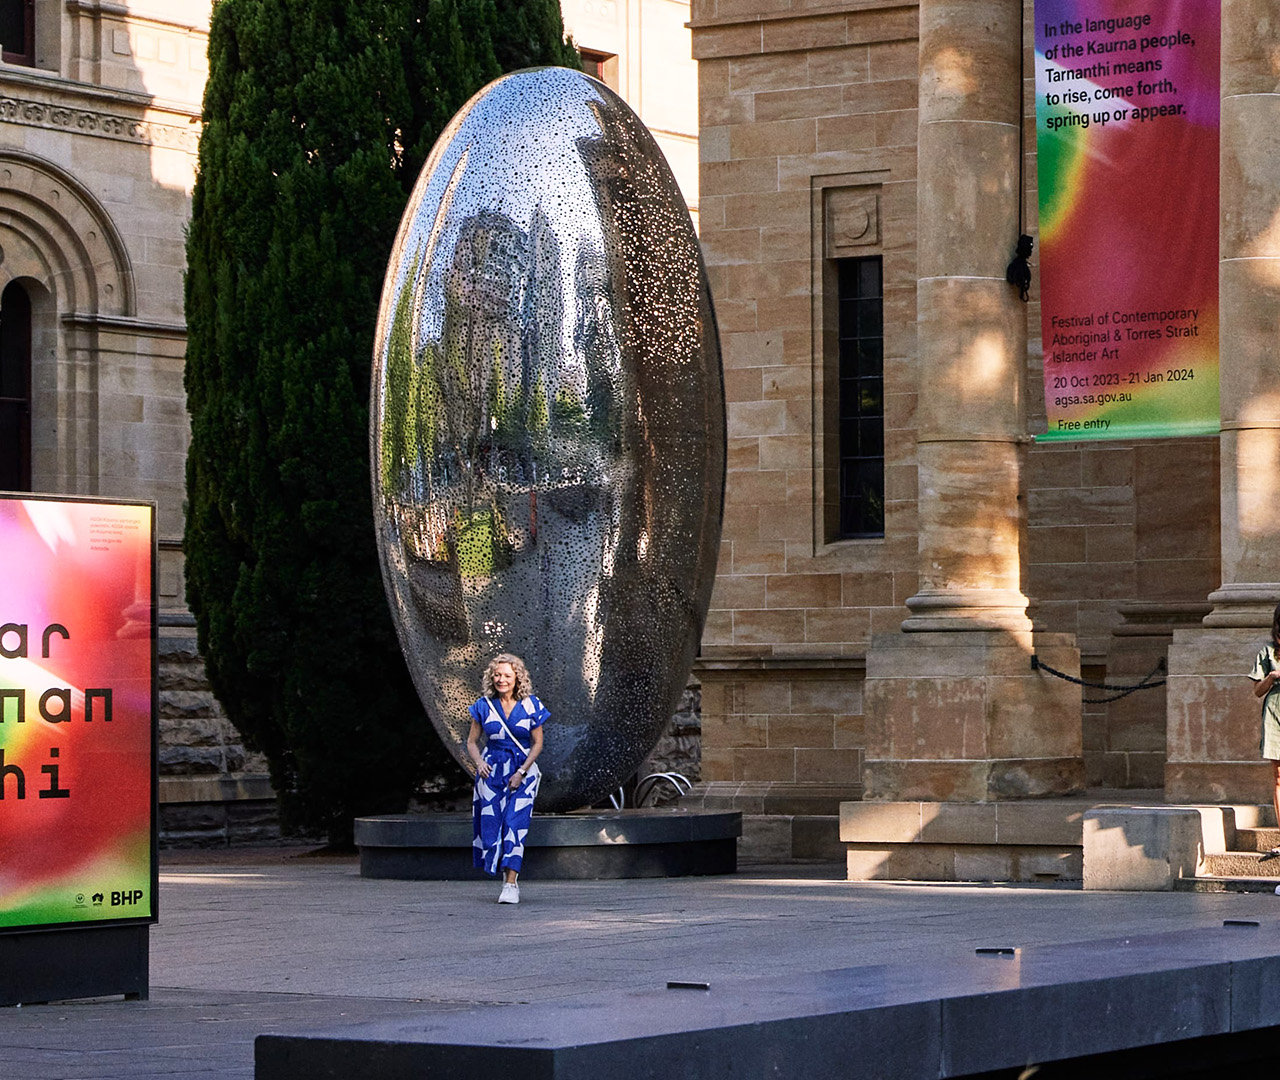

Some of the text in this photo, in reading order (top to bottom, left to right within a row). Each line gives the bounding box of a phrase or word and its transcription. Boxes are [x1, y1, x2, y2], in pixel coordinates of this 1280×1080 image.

[1045, 15, 1150, 38] In the language
[1045, 30, 1195, 60] of the Kaurna people,
[1045, 60, 1162, 82] Tarnanthi means
[1046, 78, 1176, 105] to rise, come forth,
[1047, 104, 1186, 131] spring up or appear.
[1052, 309, 1198, 328] Festival of Contemporary
[1052, 326, 1198, 347] Aboriginal & Torres Strait
[1053, 347, 1119, 363] Islander Art
[1054, 377, 1067, 388] 20
[1070, 376, 1089, 387] Oct
[1144, 372, 1163, 383] Jan
[1167, 369, 1194, 381] 2024
[1055, 393, 1132, 408] agsa.sa.gov.au
[1058, 419, 1110, 430] Free entry
[111, 890, 142, 906] BHP
